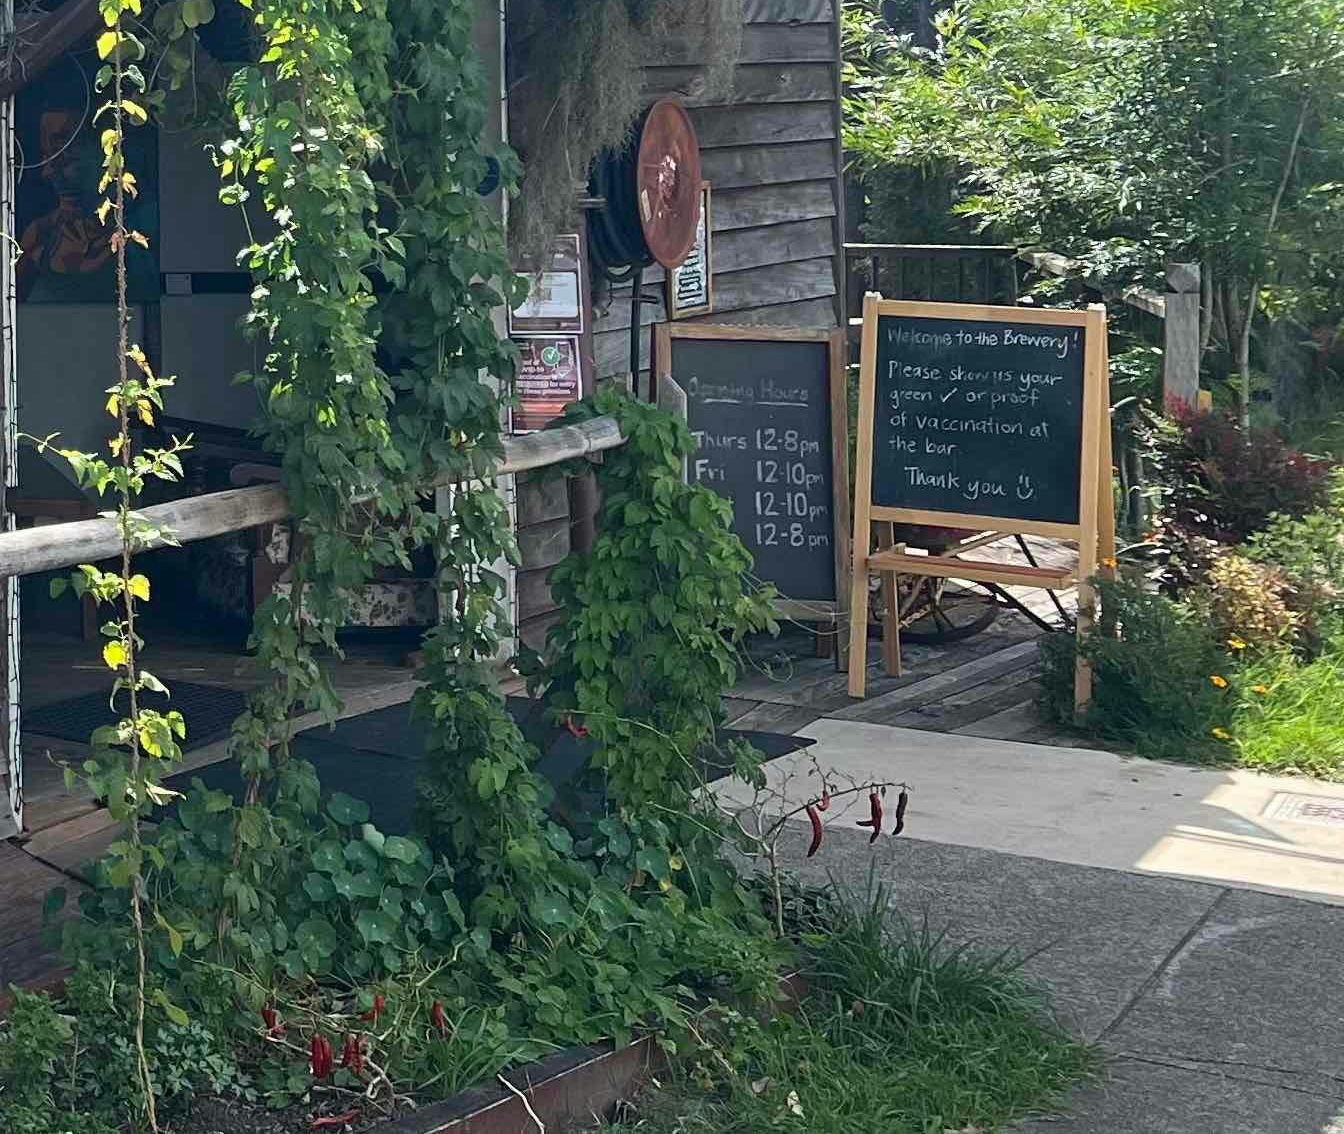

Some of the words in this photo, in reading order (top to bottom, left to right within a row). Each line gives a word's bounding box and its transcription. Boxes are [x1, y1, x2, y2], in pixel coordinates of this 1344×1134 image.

[887, 328, 952, 347] Welcome
[958, 329, 972, 345] to
[973, 331, 999, 346] the
[888, 360, 942, 380] Please
[949, 365, 990, 382] show
[992, 370, 1013, 383] us
[1019, 372, 1063, 392] your
[758, 378, 809, 400] Hours
[889, 389, 933, 410] green
[966, 391, 988, 403] or
[991, 388, 1041, 410] proof
[889, 409, 909, 428] of
[915, 415, 1024, 436] vaccination
[1029, 420, 1050, 438] at
[690, 429, 748, 450] Thurs
[888, 435, 917, 454] the
[925, 437, 959, 456] bar
[694, 458, 726, 482] Fri
[903, 465, 961, 490] Thank
[962, 478, 1008, 501] you
